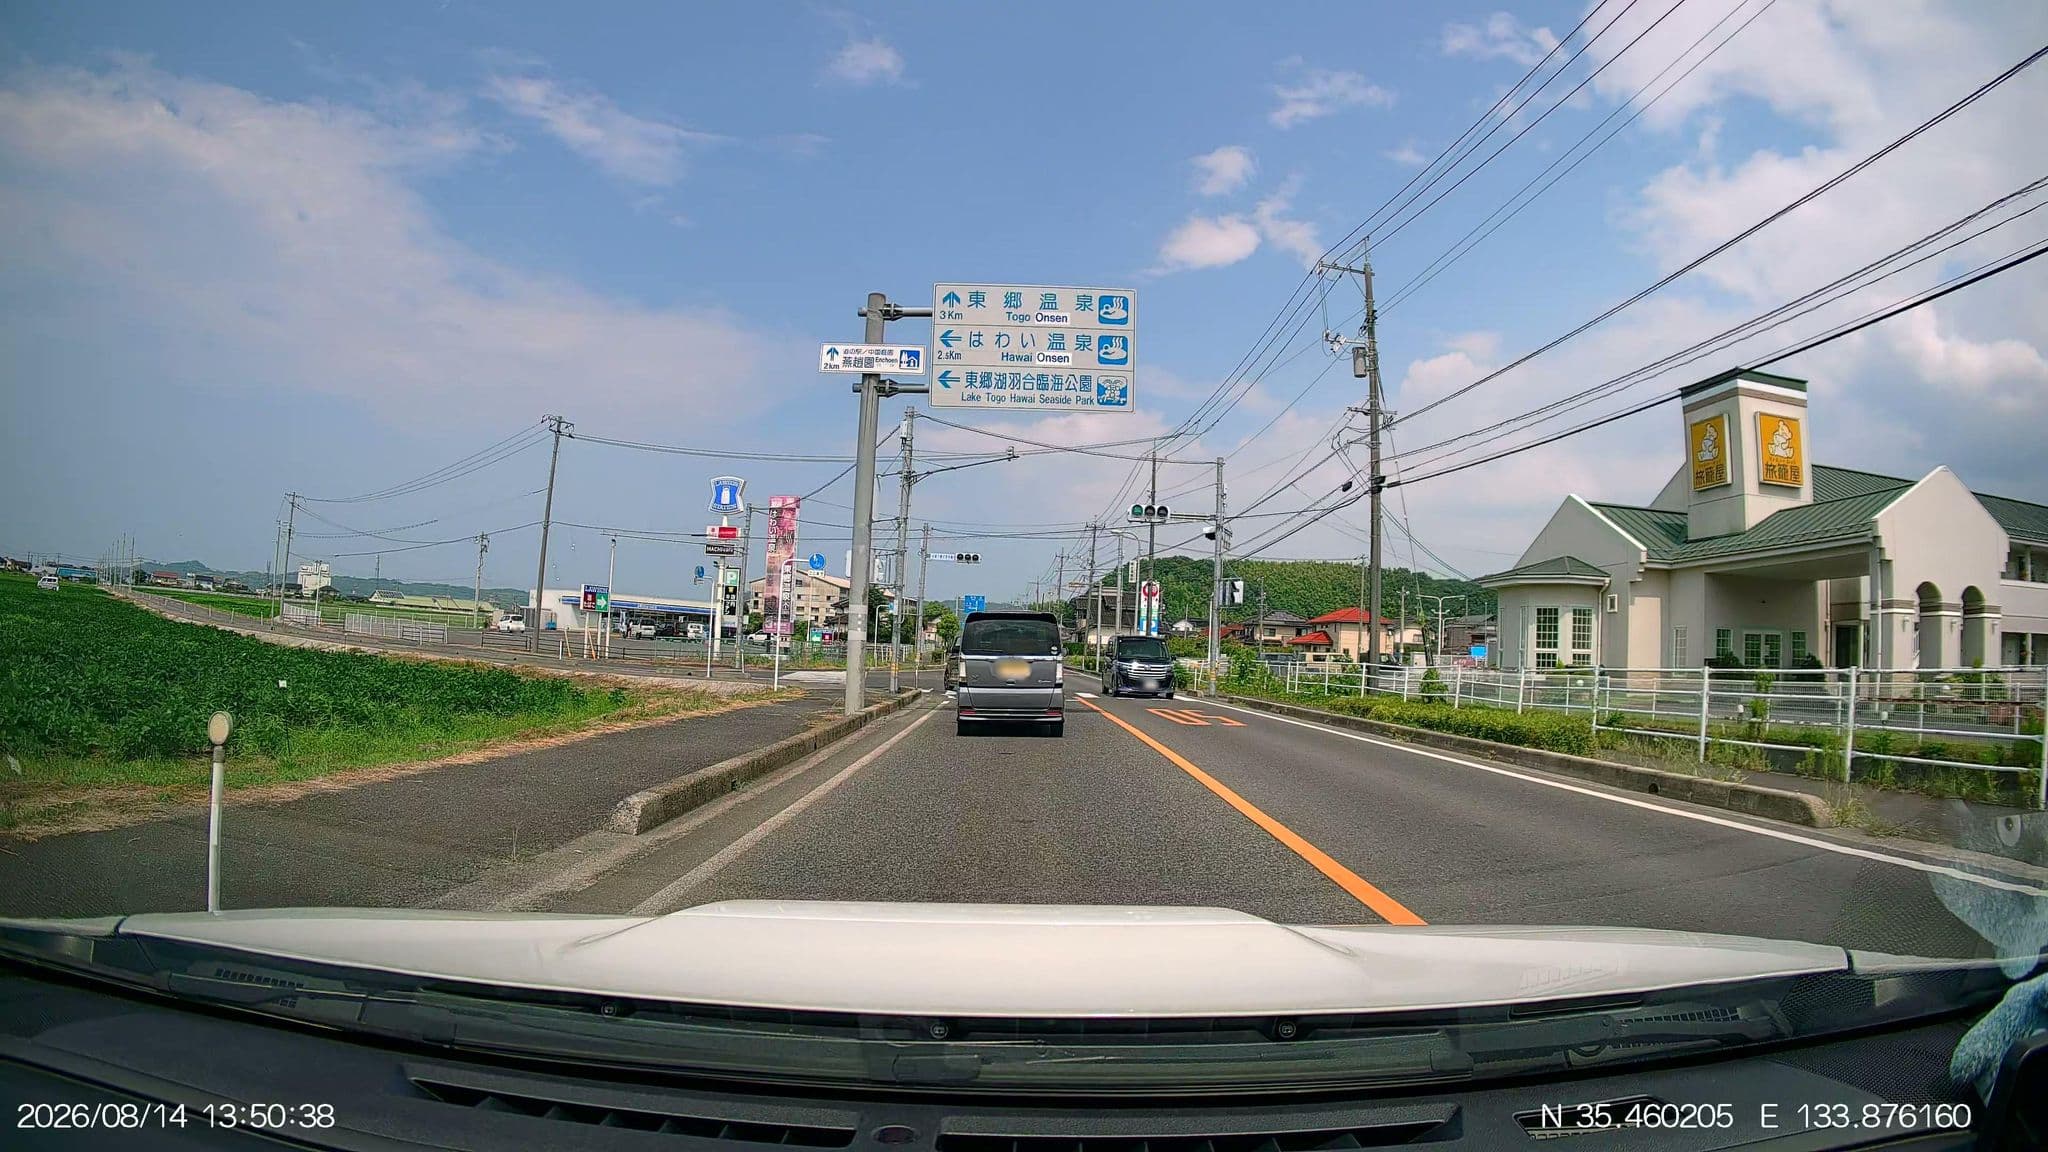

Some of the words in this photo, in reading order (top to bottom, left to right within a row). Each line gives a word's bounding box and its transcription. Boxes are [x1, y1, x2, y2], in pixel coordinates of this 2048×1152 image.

[967, 290, 1094, 312] 東郷温泉
[1006, 311, 1030, 322] Togo
[1035, 312, 1068, 323] Onsen
[968, 330, 1093, 352] はわい温泉
[1001, 352, 1033, 363] Hawai
[1036, 352, 1070, 363] Onsen
[964, 371, 1092, 393] 東郷湖羽合臨海公園
[961, 391, 981, 402] Lake
[986, 392, 1006, 404] Togo
[1010, 393, 1036, 404] Hawai
[1039, 394, 1072, 405] Seaside
[1075, 395, 1095, 406] Park
